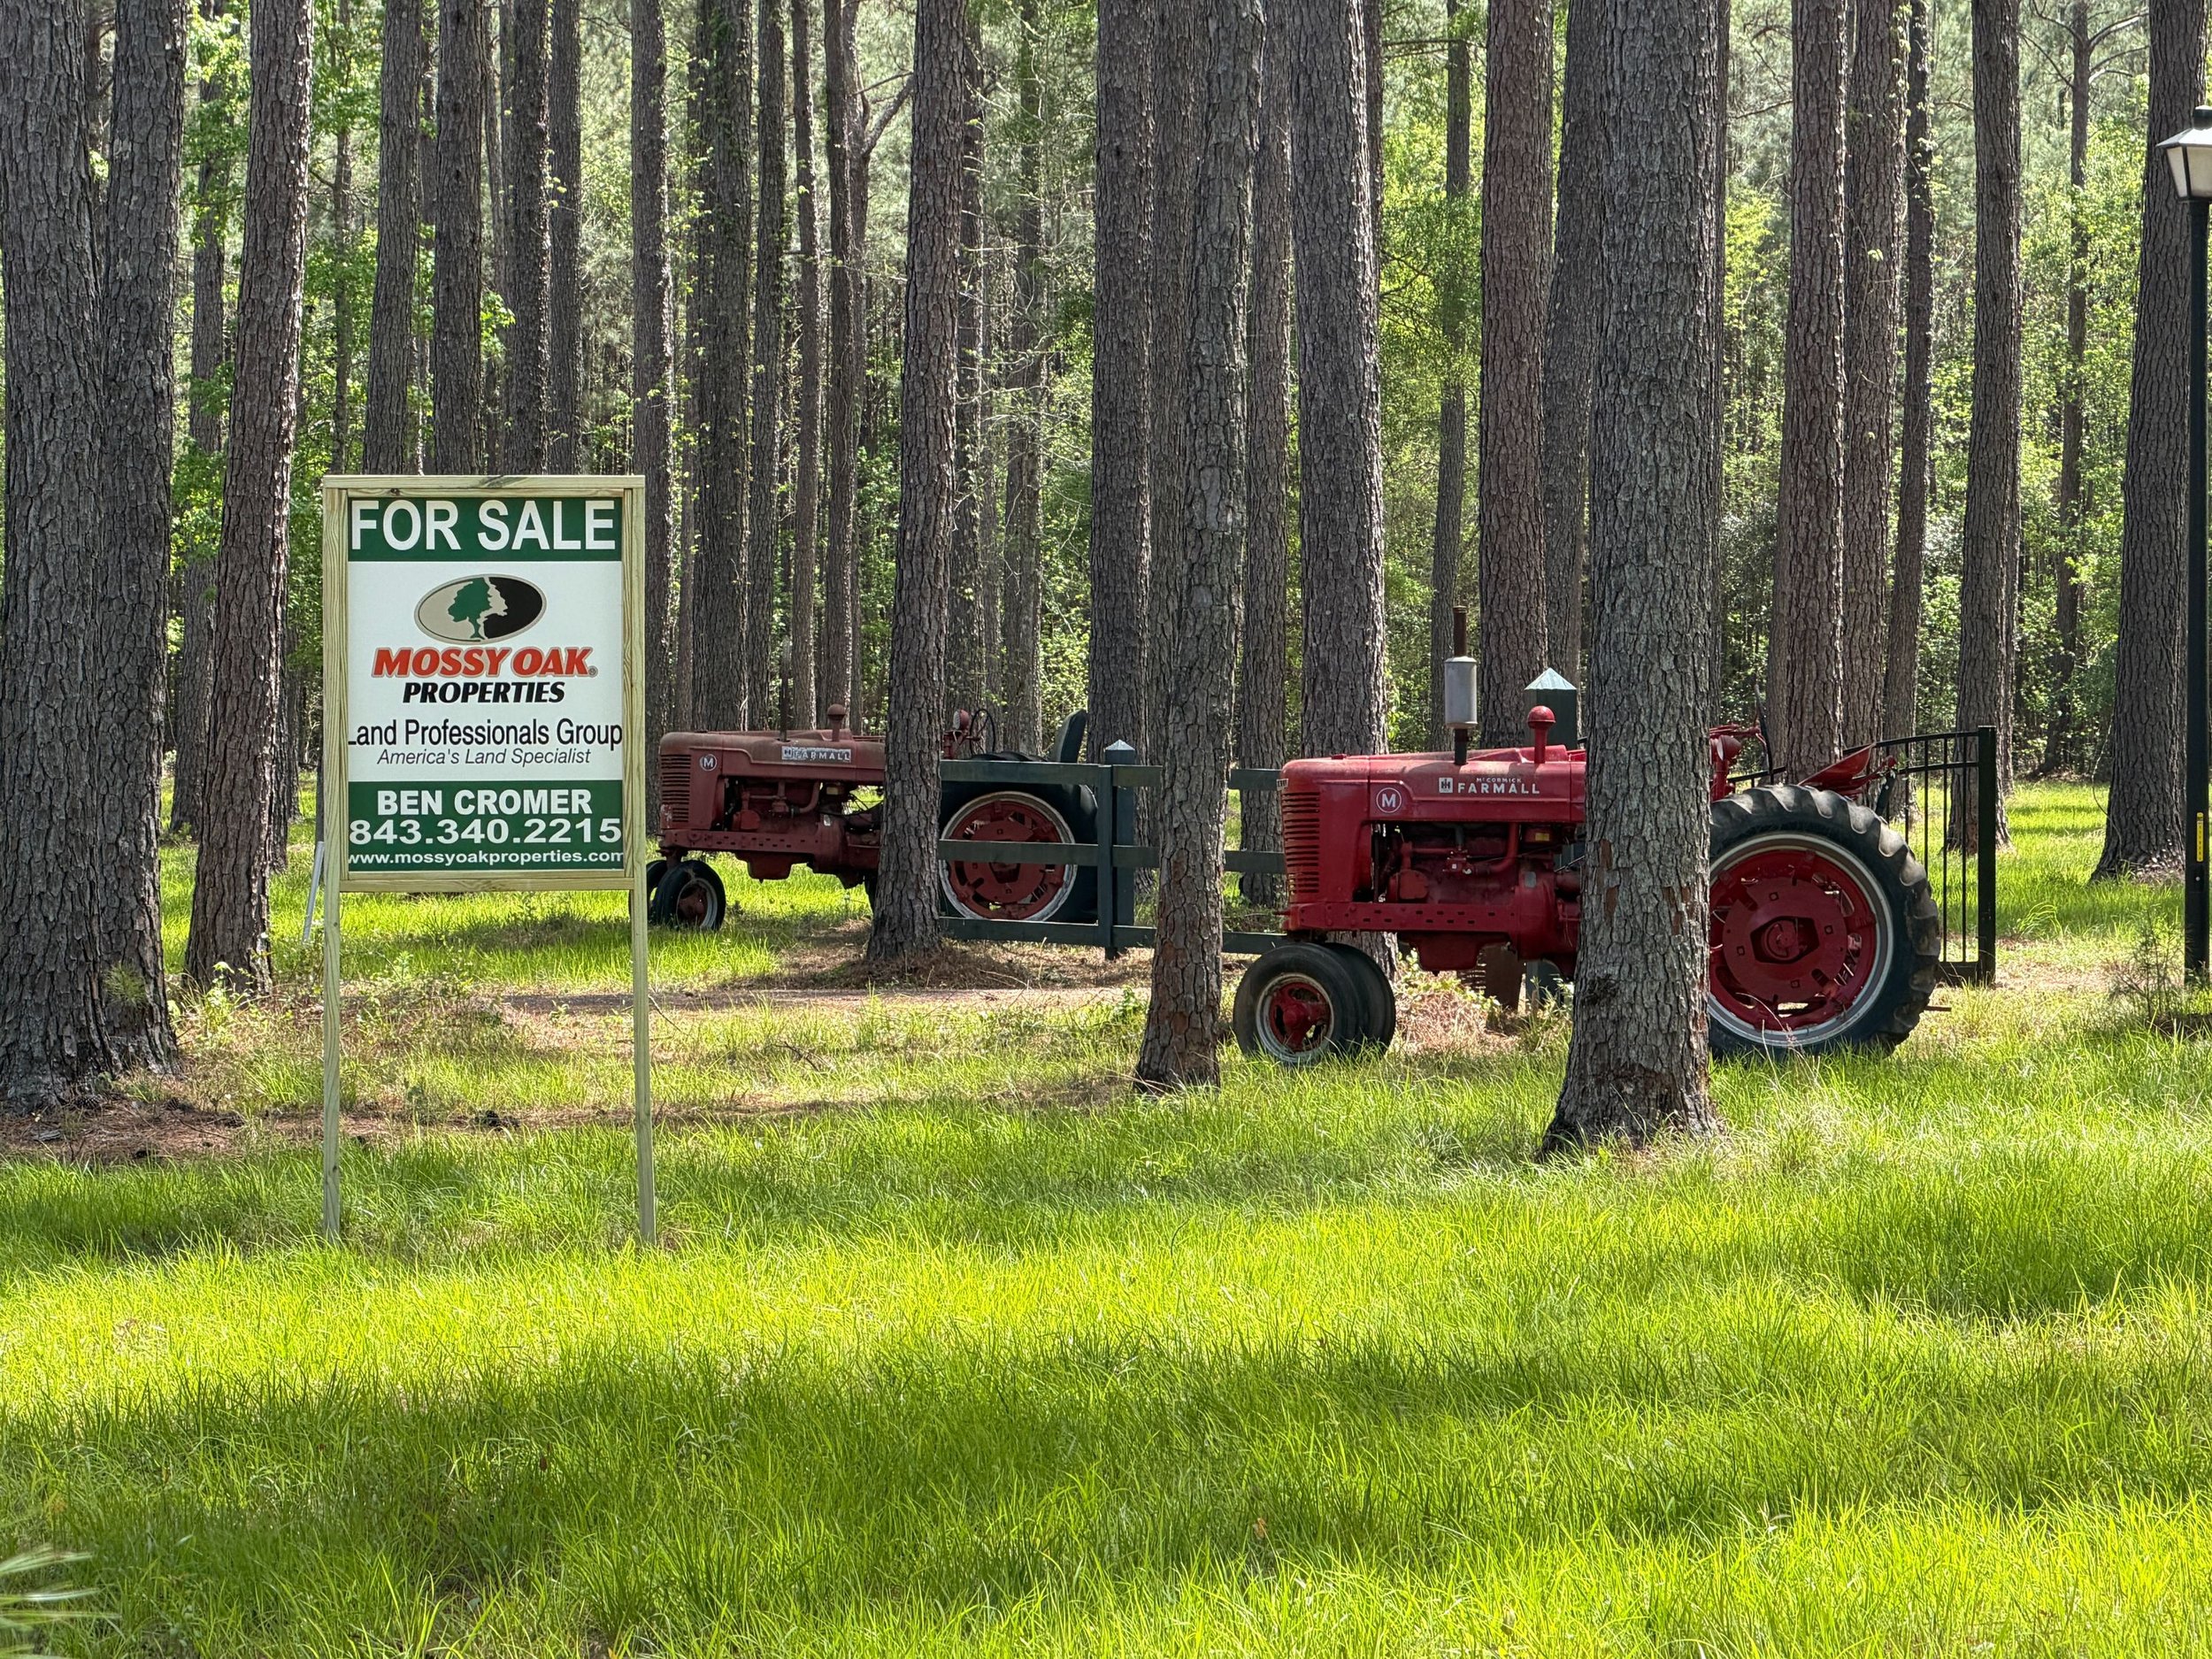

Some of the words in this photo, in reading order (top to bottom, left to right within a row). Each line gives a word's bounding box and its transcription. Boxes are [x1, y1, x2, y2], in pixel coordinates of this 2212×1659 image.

[351, 500, 461, 550] FOR
[478, 500, 616, 551] SALE
[372, 647, 512, 678] MOSSY
[403, 681, 565, 703] PROPERTIES
[405, 718, 549, 746] Professionals
[557, 718, 623, 751] Group
[377, 749, 460, 764] America's
[465, 749, 507, 764] Land
[511, 748, 592, 767] Specialist
[1457, 782, 1540, 795] FARMALL
[377, 790, 443, 816] BEN
[454, 789, 593, 816] CROMER
[349, 818, 622, 845] 843.340.2215
[348, 849, 624, 866] www.mossyoakproperties.com
